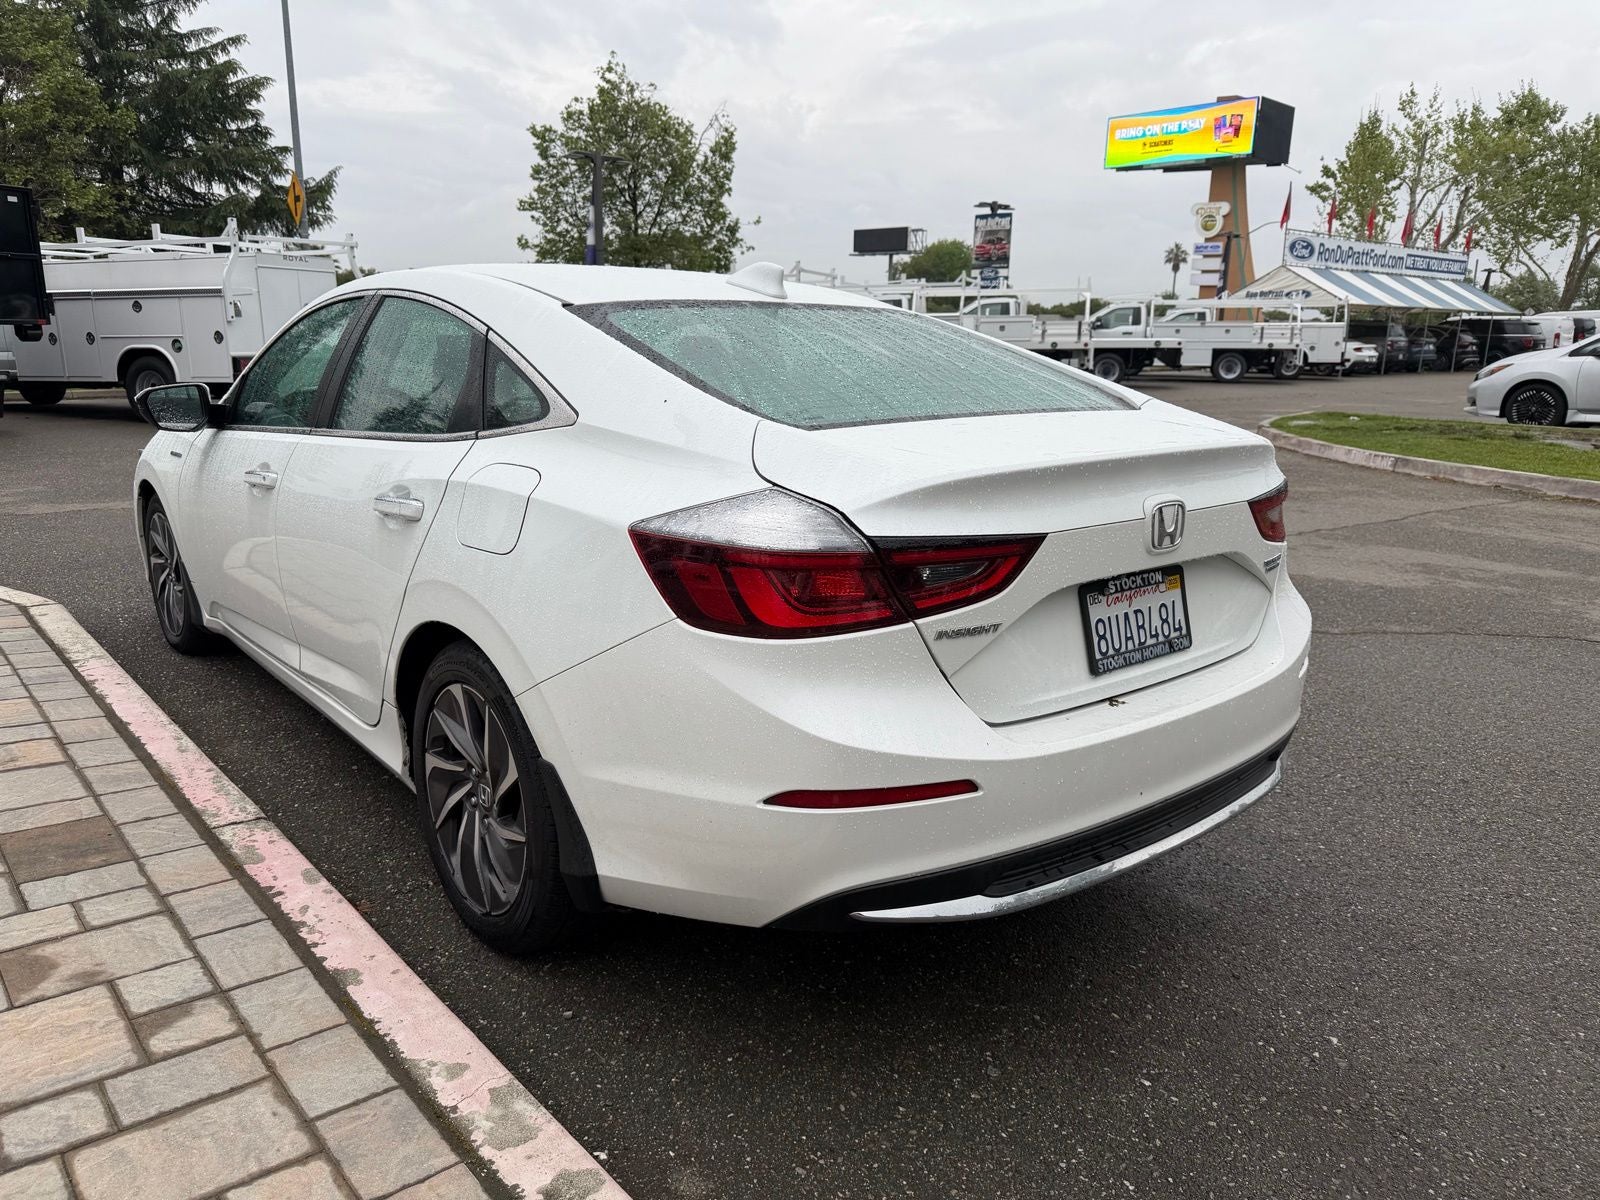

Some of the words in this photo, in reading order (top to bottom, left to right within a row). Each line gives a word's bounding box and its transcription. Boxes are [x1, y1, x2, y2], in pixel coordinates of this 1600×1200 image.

[1115, 127, 1144, 140] BRING
[1145, 124, 1160, 136] ON
[1162, 121, 1180, 134] THE
[1292, 240, 1312, 257] Ford
[1317, 242, 1405, 270] RonDuPrattFord.com
[283, 255, 308, 263] ROYAL
[1406, 256, 1415, 268] WE
[1414, 257, 1429, 270] TREAT
[1429, 259, 1440, 271] YOU
[1439, 260, 1449, 272] LIKE
[1108, 570, 1163, 594] STOCKTON
[1088, 593, 1103, 606] DEC
[1105, 583, 1162, 608] California
[934, 622, 1003, 641] INSIGHT
[1094, 599, 1184, 658] 8UAB484
